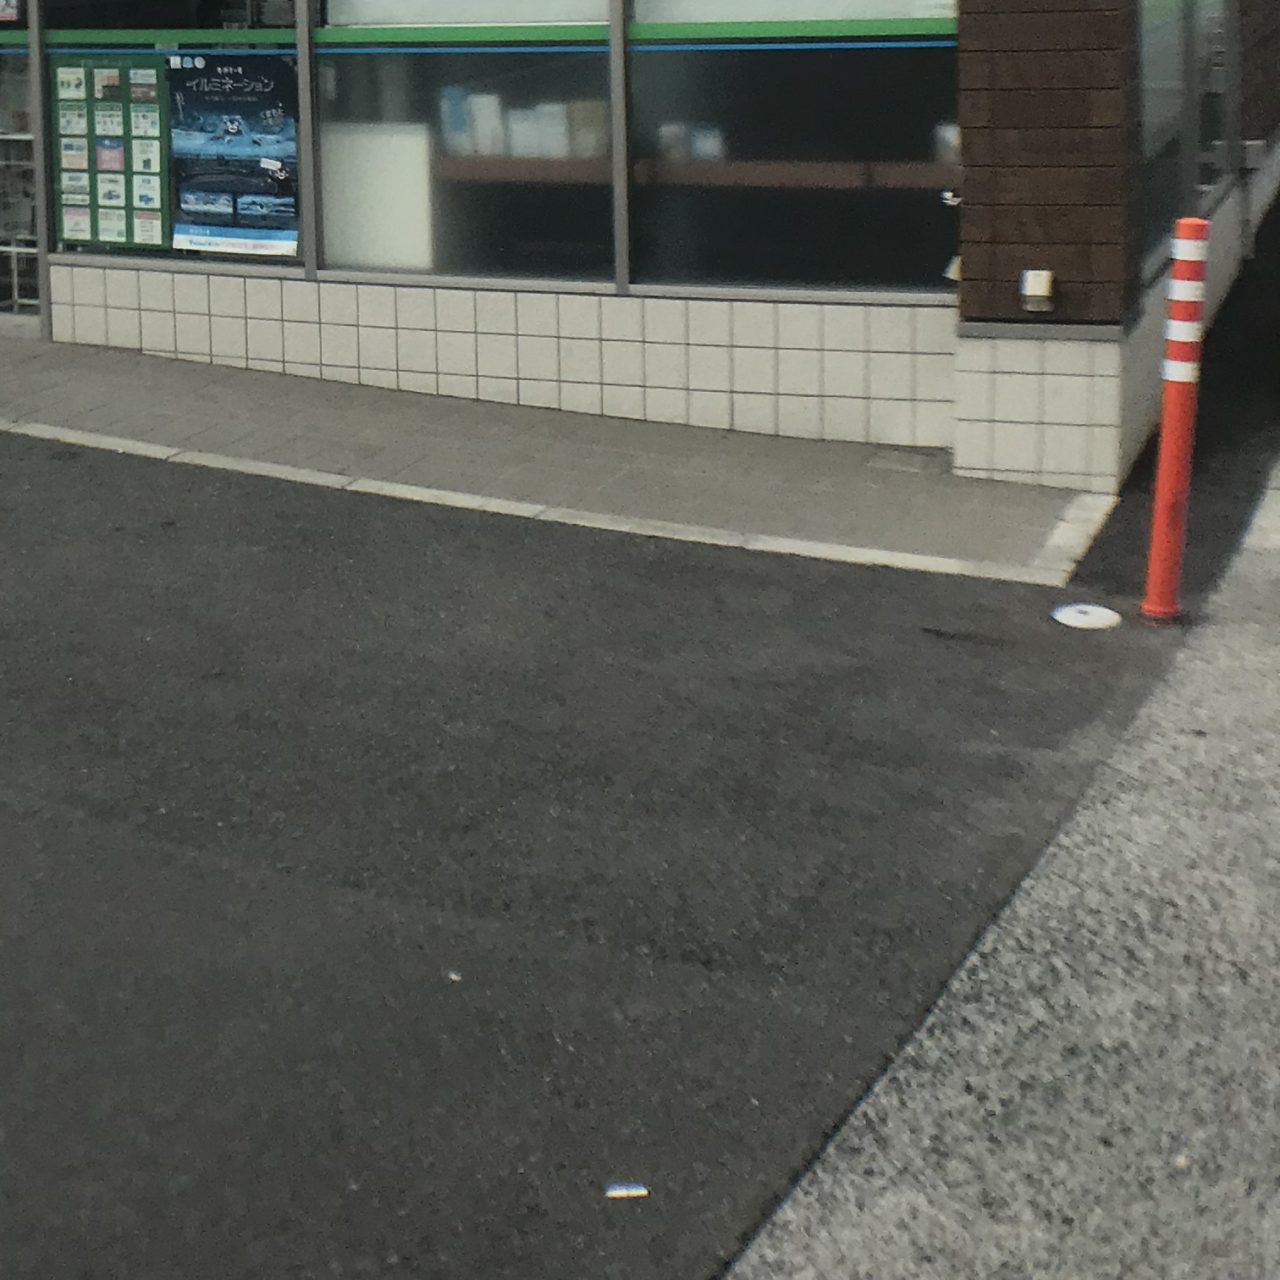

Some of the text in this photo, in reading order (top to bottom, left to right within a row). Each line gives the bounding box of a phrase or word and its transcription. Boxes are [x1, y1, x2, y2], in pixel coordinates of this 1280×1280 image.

[185, 76, 274, 92] イルミネーション
